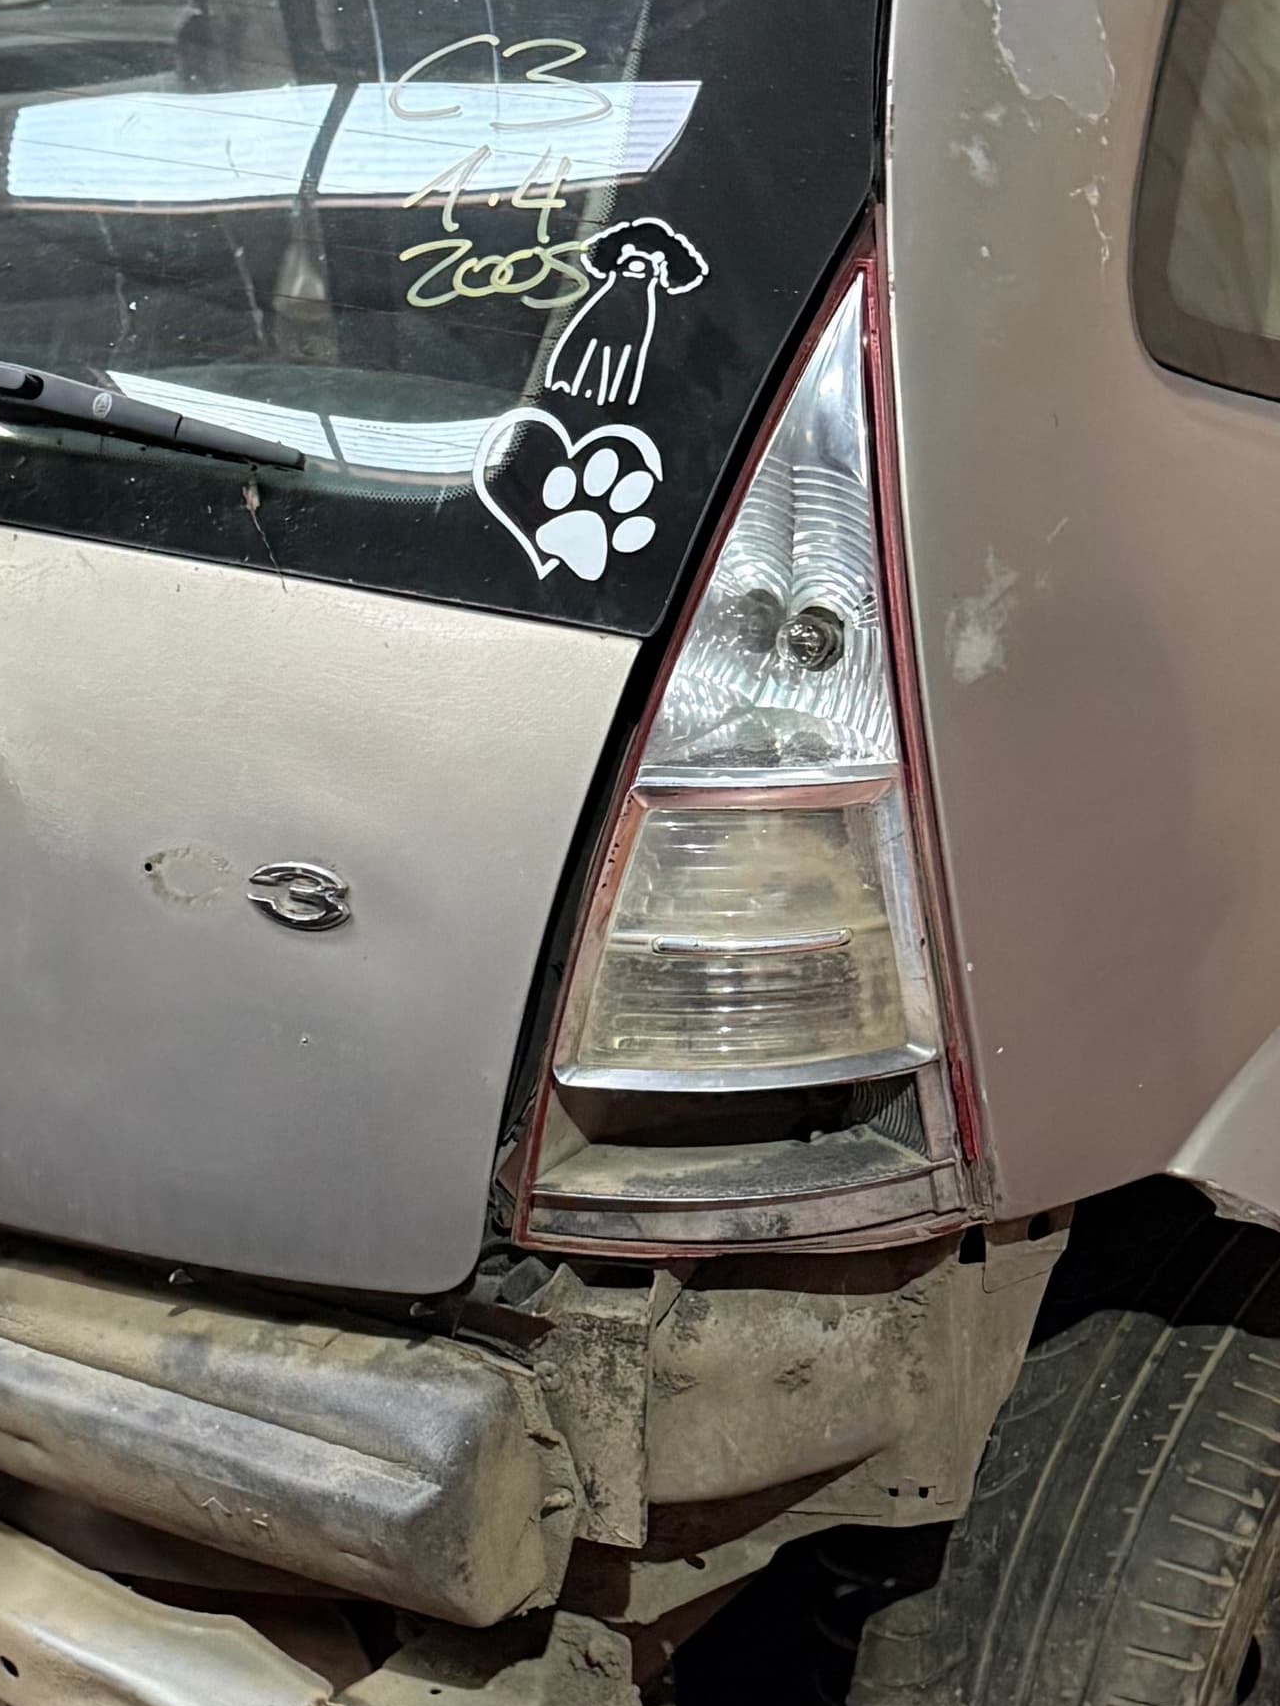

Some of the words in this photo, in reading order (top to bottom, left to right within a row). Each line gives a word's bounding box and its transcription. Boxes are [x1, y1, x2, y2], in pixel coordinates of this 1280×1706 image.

[389, 34, 612, 130] C3
[401, 144, 571, 243] 1.4
[399, 238, 590, 309] 2005
